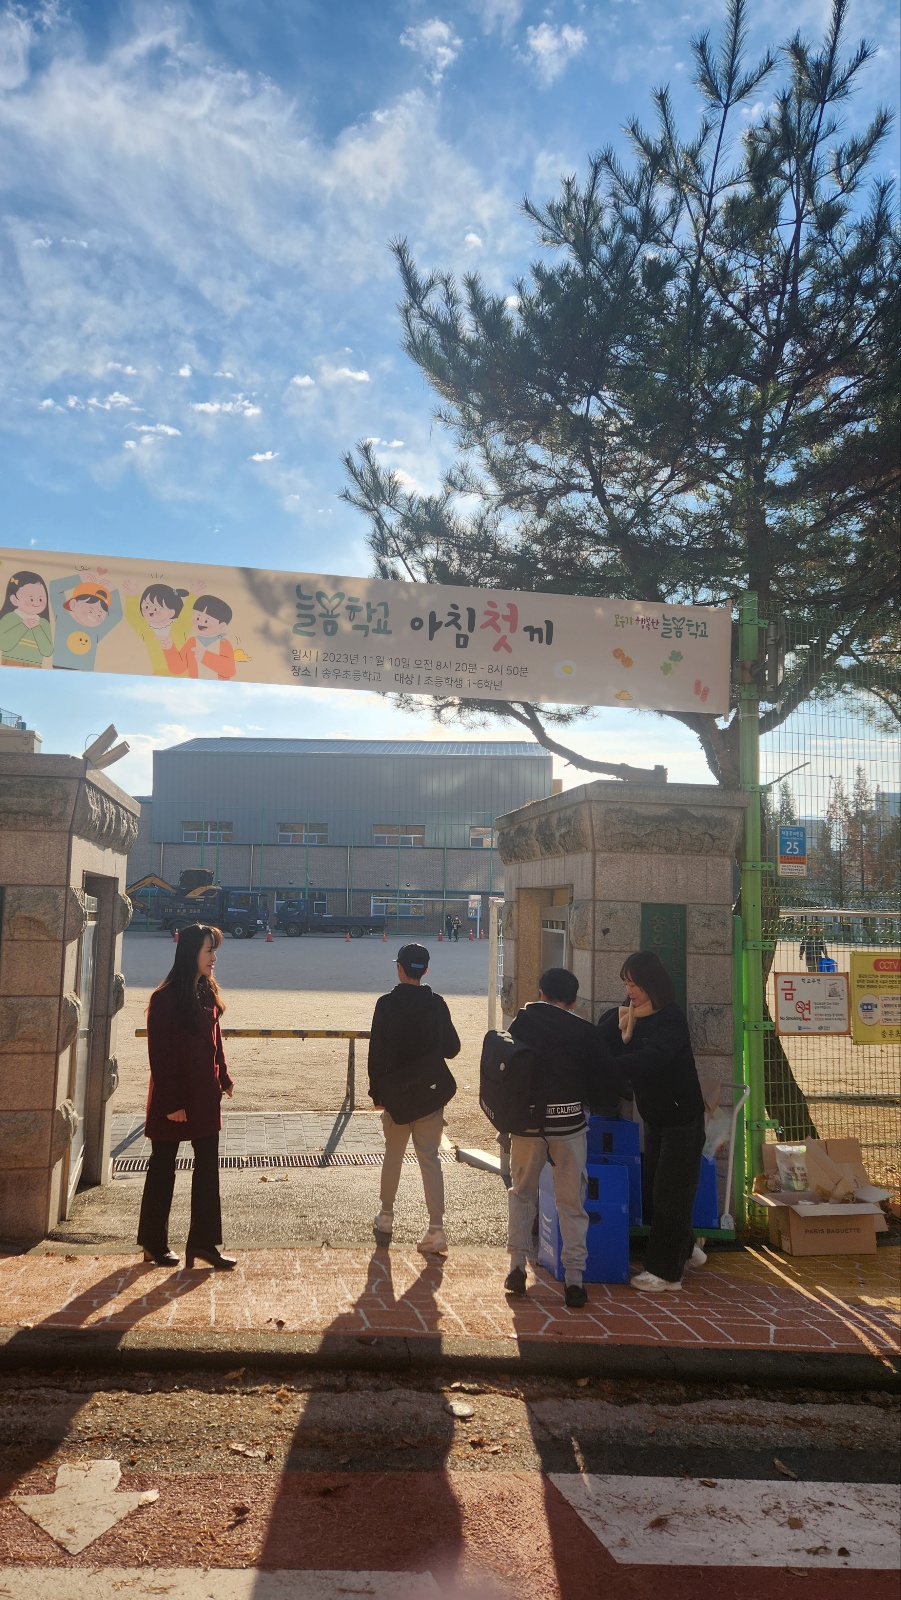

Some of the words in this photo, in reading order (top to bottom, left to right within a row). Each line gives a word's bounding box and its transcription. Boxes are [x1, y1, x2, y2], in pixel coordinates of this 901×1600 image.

[292, 584, 392, 638] 늘봄학교
[614, 614, 634, 629] 모두가
[635, 616, 660, 631] 행복한
[661, 613, 709, 639] 늘봄학교
[291, 648, 312, 662] 일시
[322, 652, 359, 665] 2023년
[388, 657, 410, 669] 10일
[413, 659, 433, 671] 오전
[436, 660, 452, 671] 8시
[455, 662, 477, 674] 20분
[487, 664, 503, 676] 8시
[506, 665, 529, 678] 50분
[291, 665, 312, 677] 장소
[322, 668, 382, 683] 송우초등학교
[394, 673, 415, 686] 대상
[424, 676, 463, 689] 초등학생
[466, 678, 503, 692] 1-6학년
[786, 841, 799, 854] 25
[879, 960, 899, 970] CCTV
